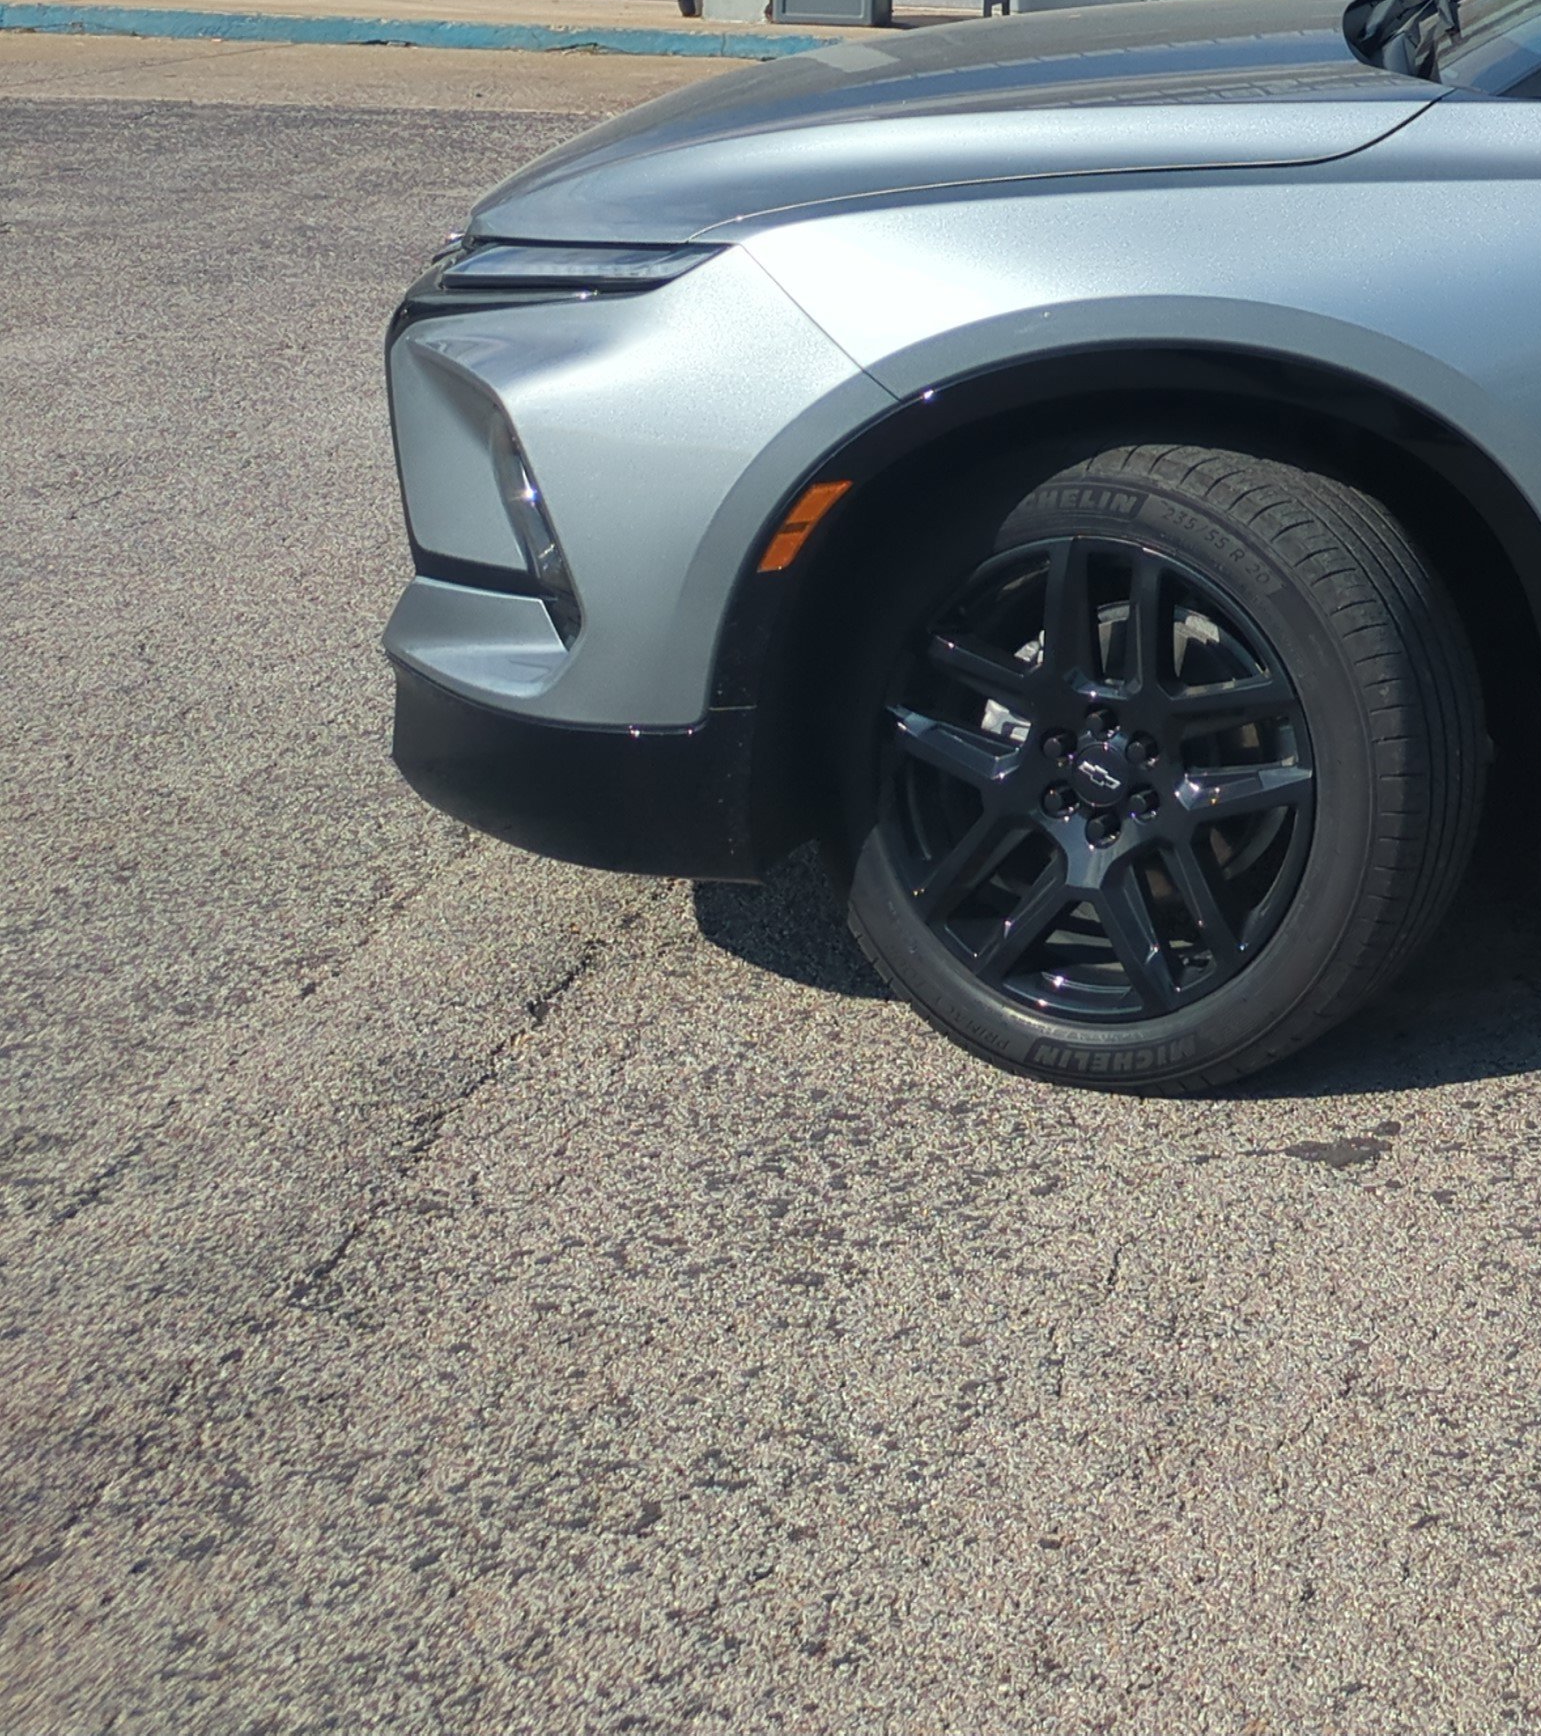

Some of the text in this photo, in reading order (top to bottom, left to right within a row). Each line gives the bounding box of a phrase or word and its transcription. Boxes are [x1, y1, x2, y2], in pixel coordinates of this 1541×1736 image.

[1160, 505, 1272, 586] 235/55 R 20
[1033, 1034, 1196, 1072] MICHELIN
